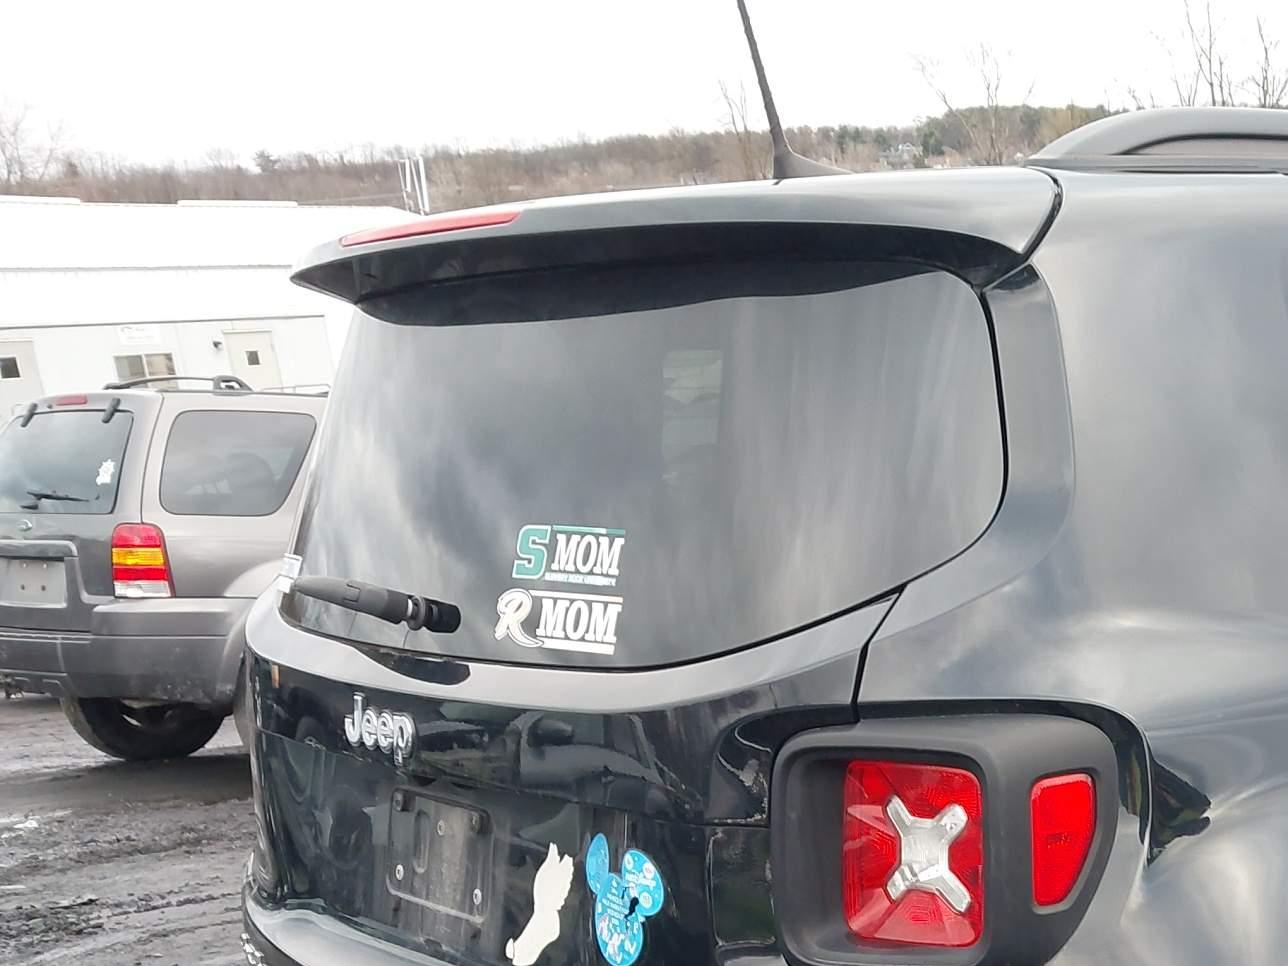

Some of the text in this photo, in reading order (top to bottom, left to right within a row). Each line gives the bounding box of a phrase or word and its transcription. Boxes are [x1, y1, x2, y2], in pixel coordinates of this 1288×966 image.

[550, 532, 626, 577] MOM
[535, 597, 623, 644] MOM
[344, 692, 415, 767] Jeep
